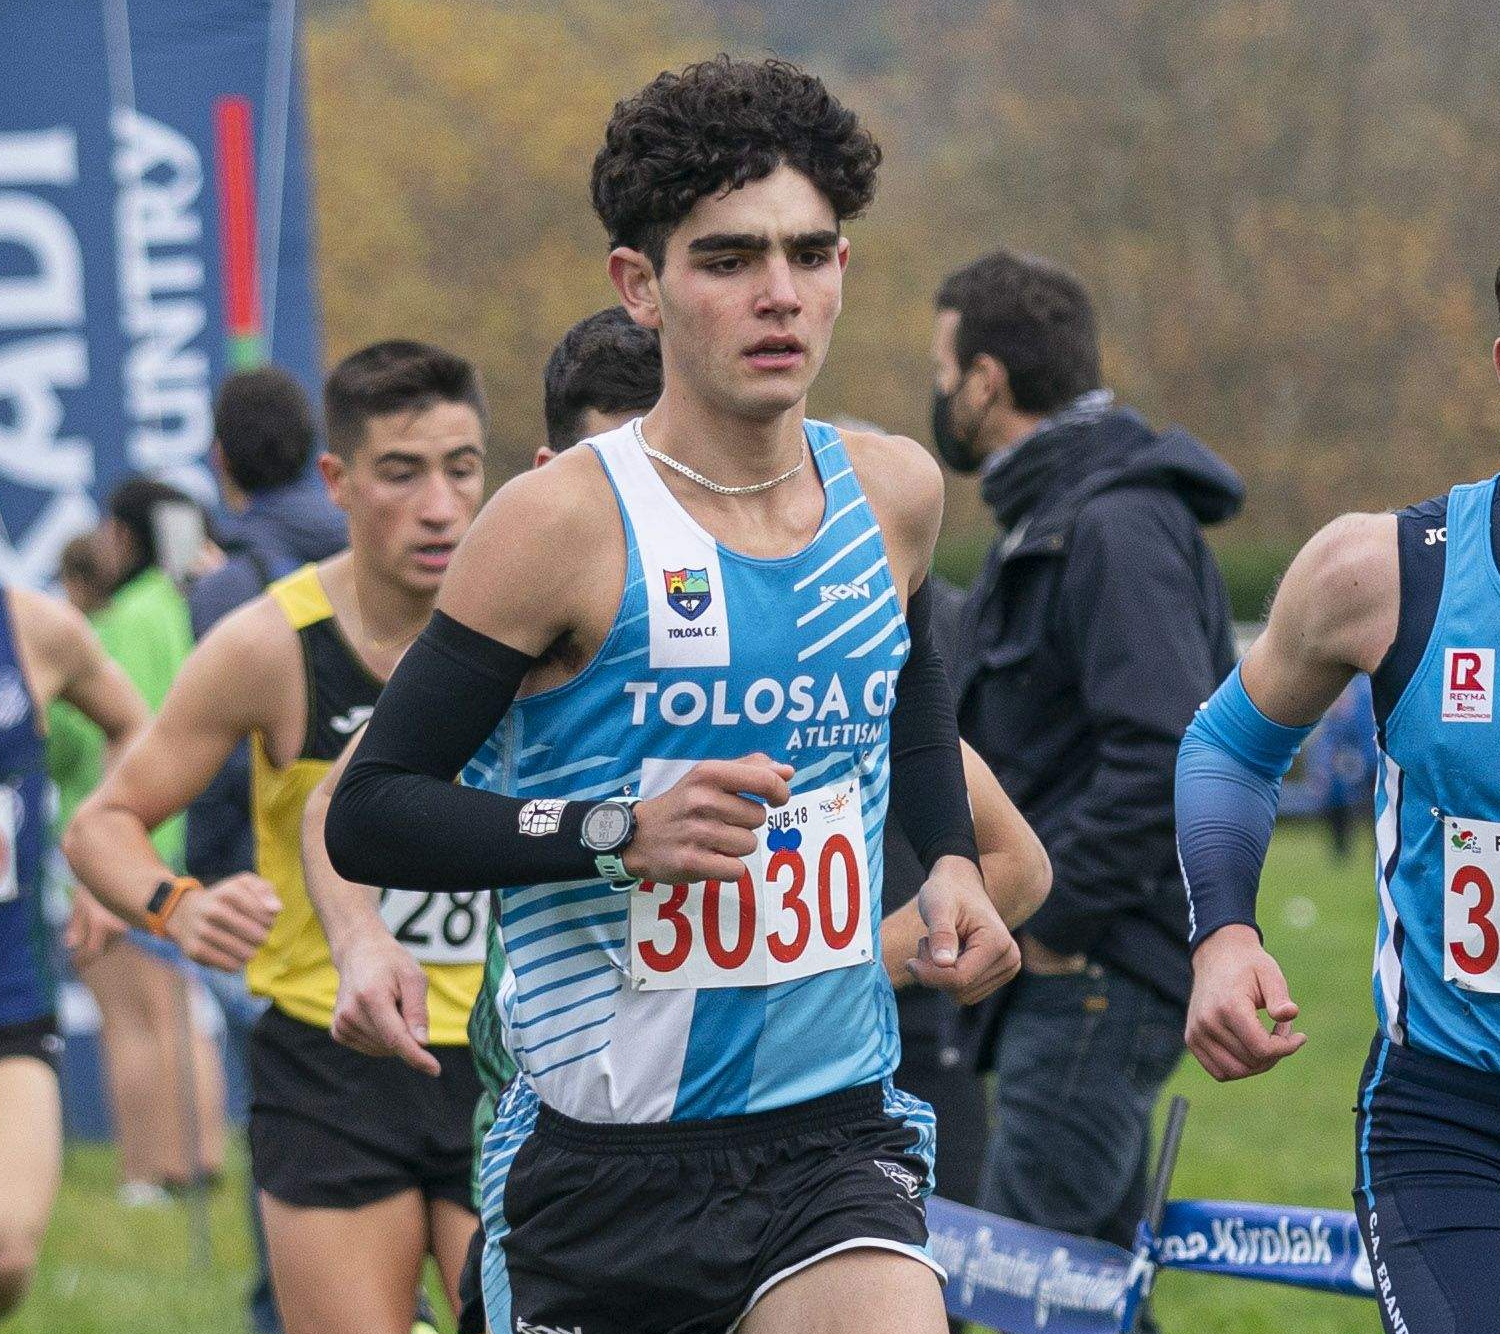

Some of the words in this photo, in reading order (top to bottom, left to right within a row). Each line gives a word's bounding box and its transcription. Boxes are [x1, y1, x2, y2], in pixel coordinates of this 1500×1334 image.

[819, 583, 870, 602] KON
[668, 627, 702, 639] TOLOSA
[623, 673, 850, 726] TOLOSA
[1449, 693, 1487, 701] REYMA
[766, 806, 808, 832] SUB-18
[381, 888, 475, 946] 28
[637, 834, 861, 973] 3030
[1207, 1215, 1334, 1265] Kirolak
[1369, 1211, 1381, 1260] C.A.
